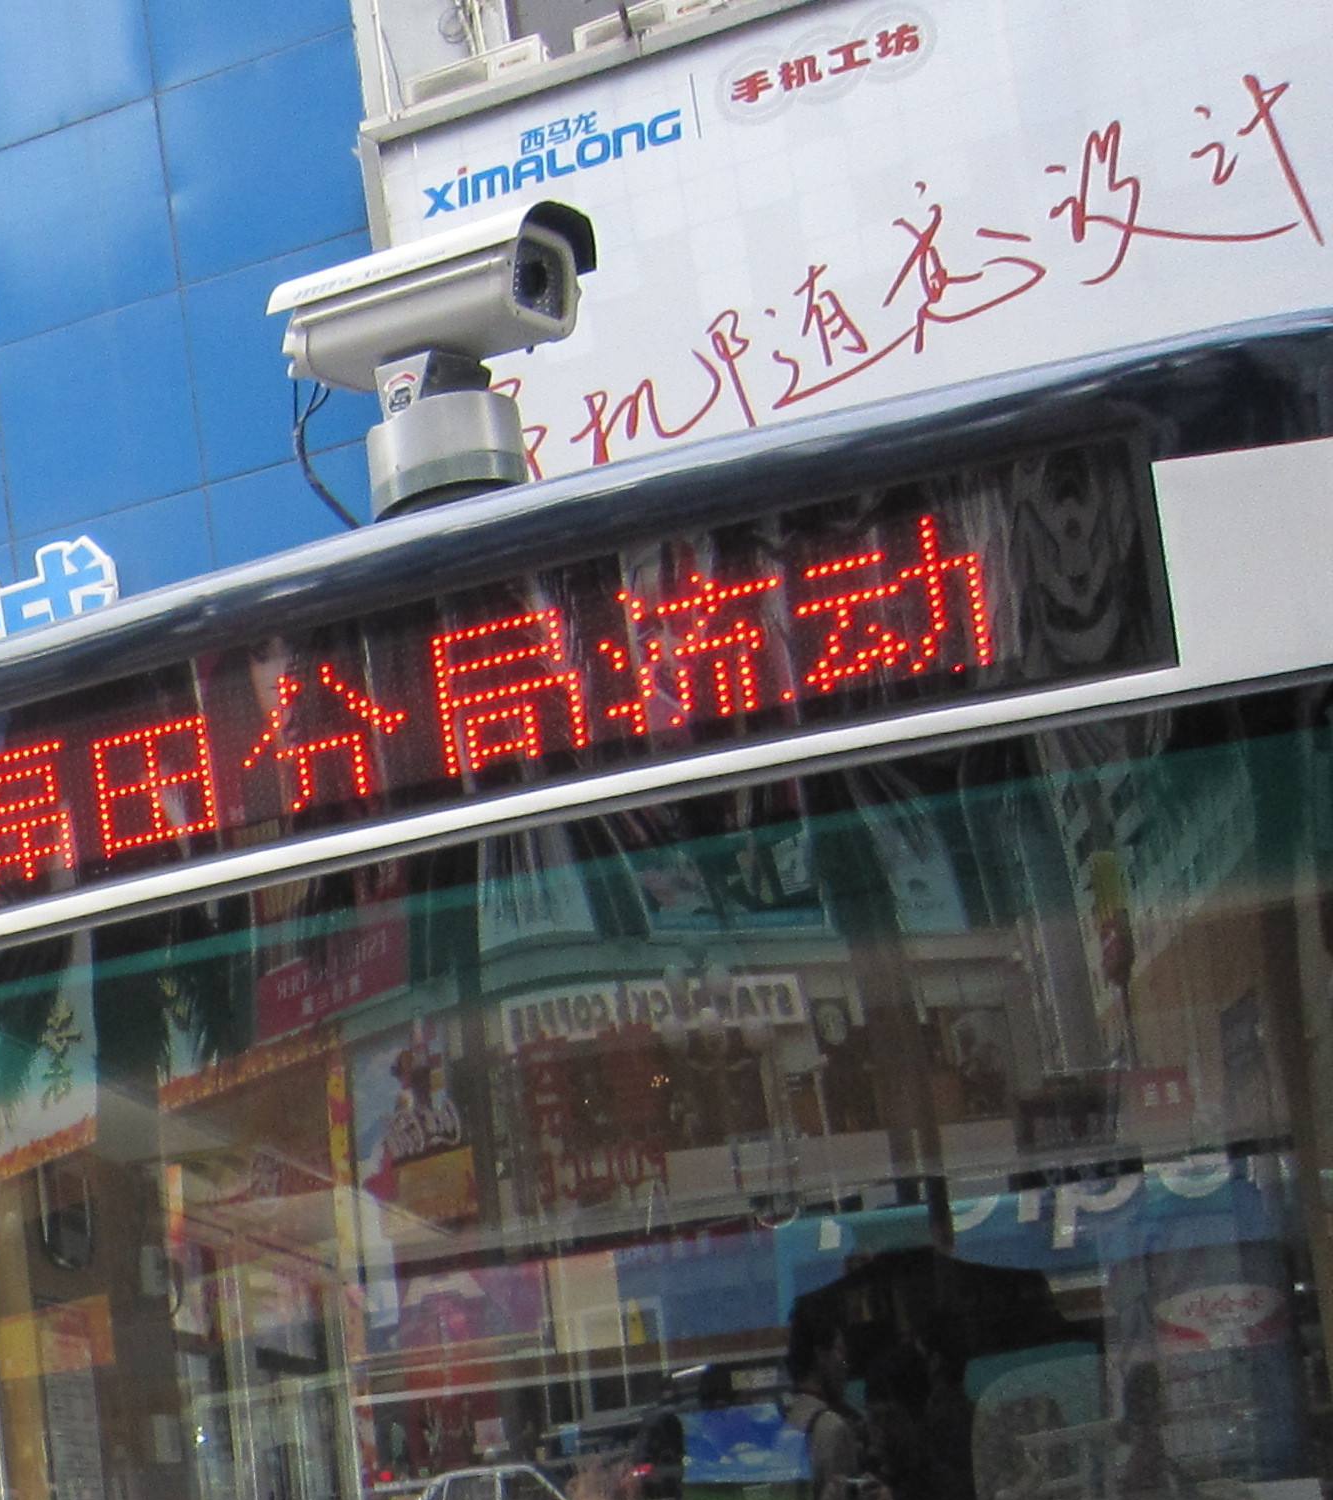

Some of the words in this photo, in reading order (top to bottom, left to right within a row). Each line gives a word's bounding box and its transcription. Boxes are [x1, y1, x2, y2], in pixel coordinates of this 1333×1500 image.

[731, 23, 920, 103] 手机工坊
[520, 111, 598, 156] 西马龙
